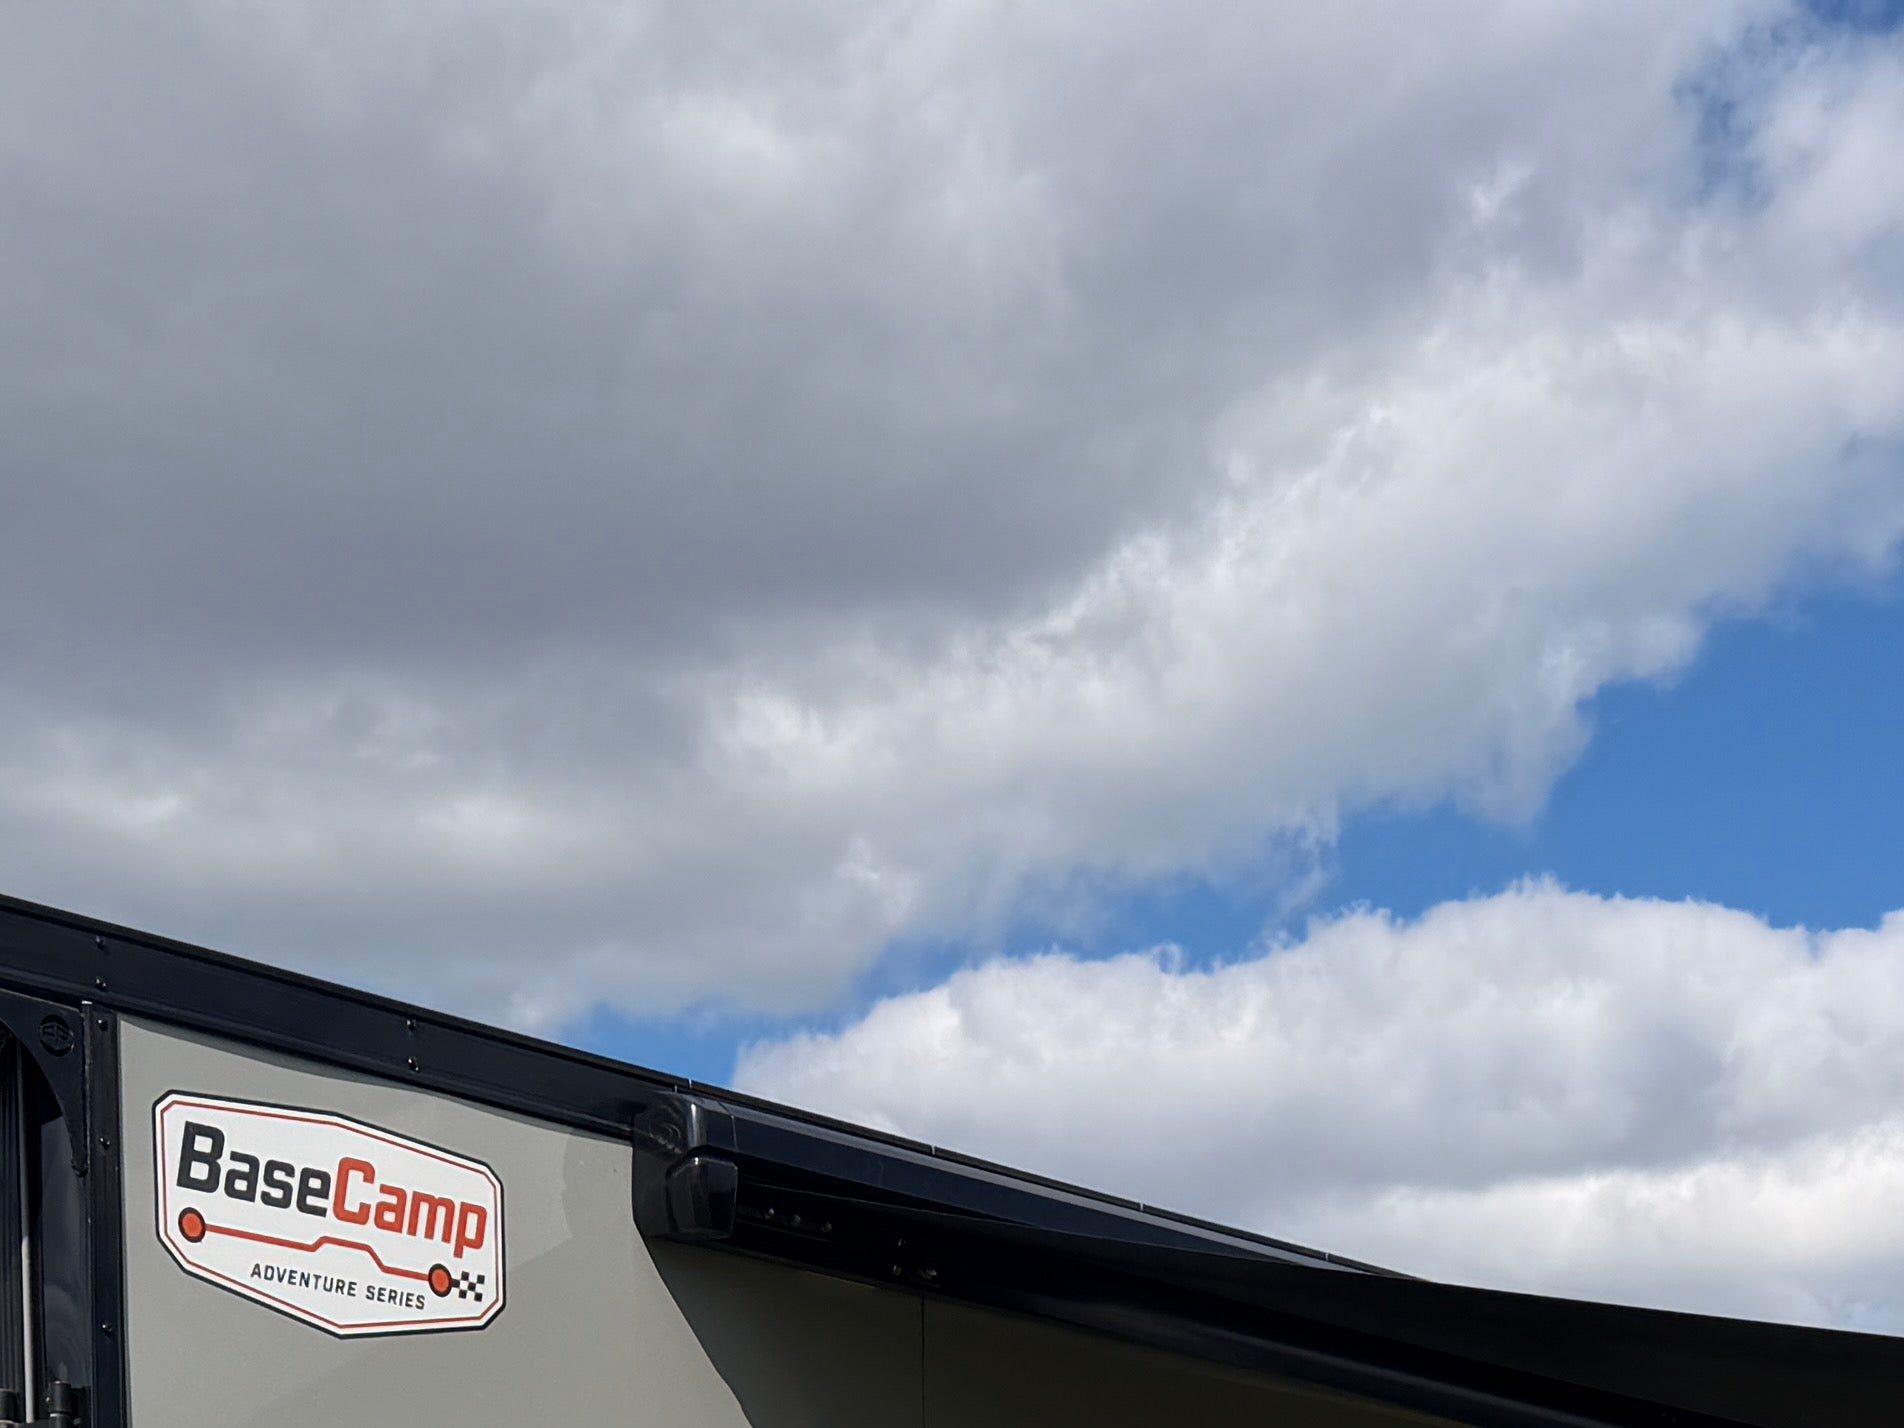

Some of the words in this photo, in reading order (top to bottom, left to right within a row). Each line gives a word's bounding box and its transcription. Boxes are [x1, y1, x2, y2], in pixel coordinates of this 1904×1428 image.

[177, 1121, 487, 1259] BaseCamp
[250, 1263, 357, 1297] ADVENTURE
[366, 1285, 426, 1310] SERIES
